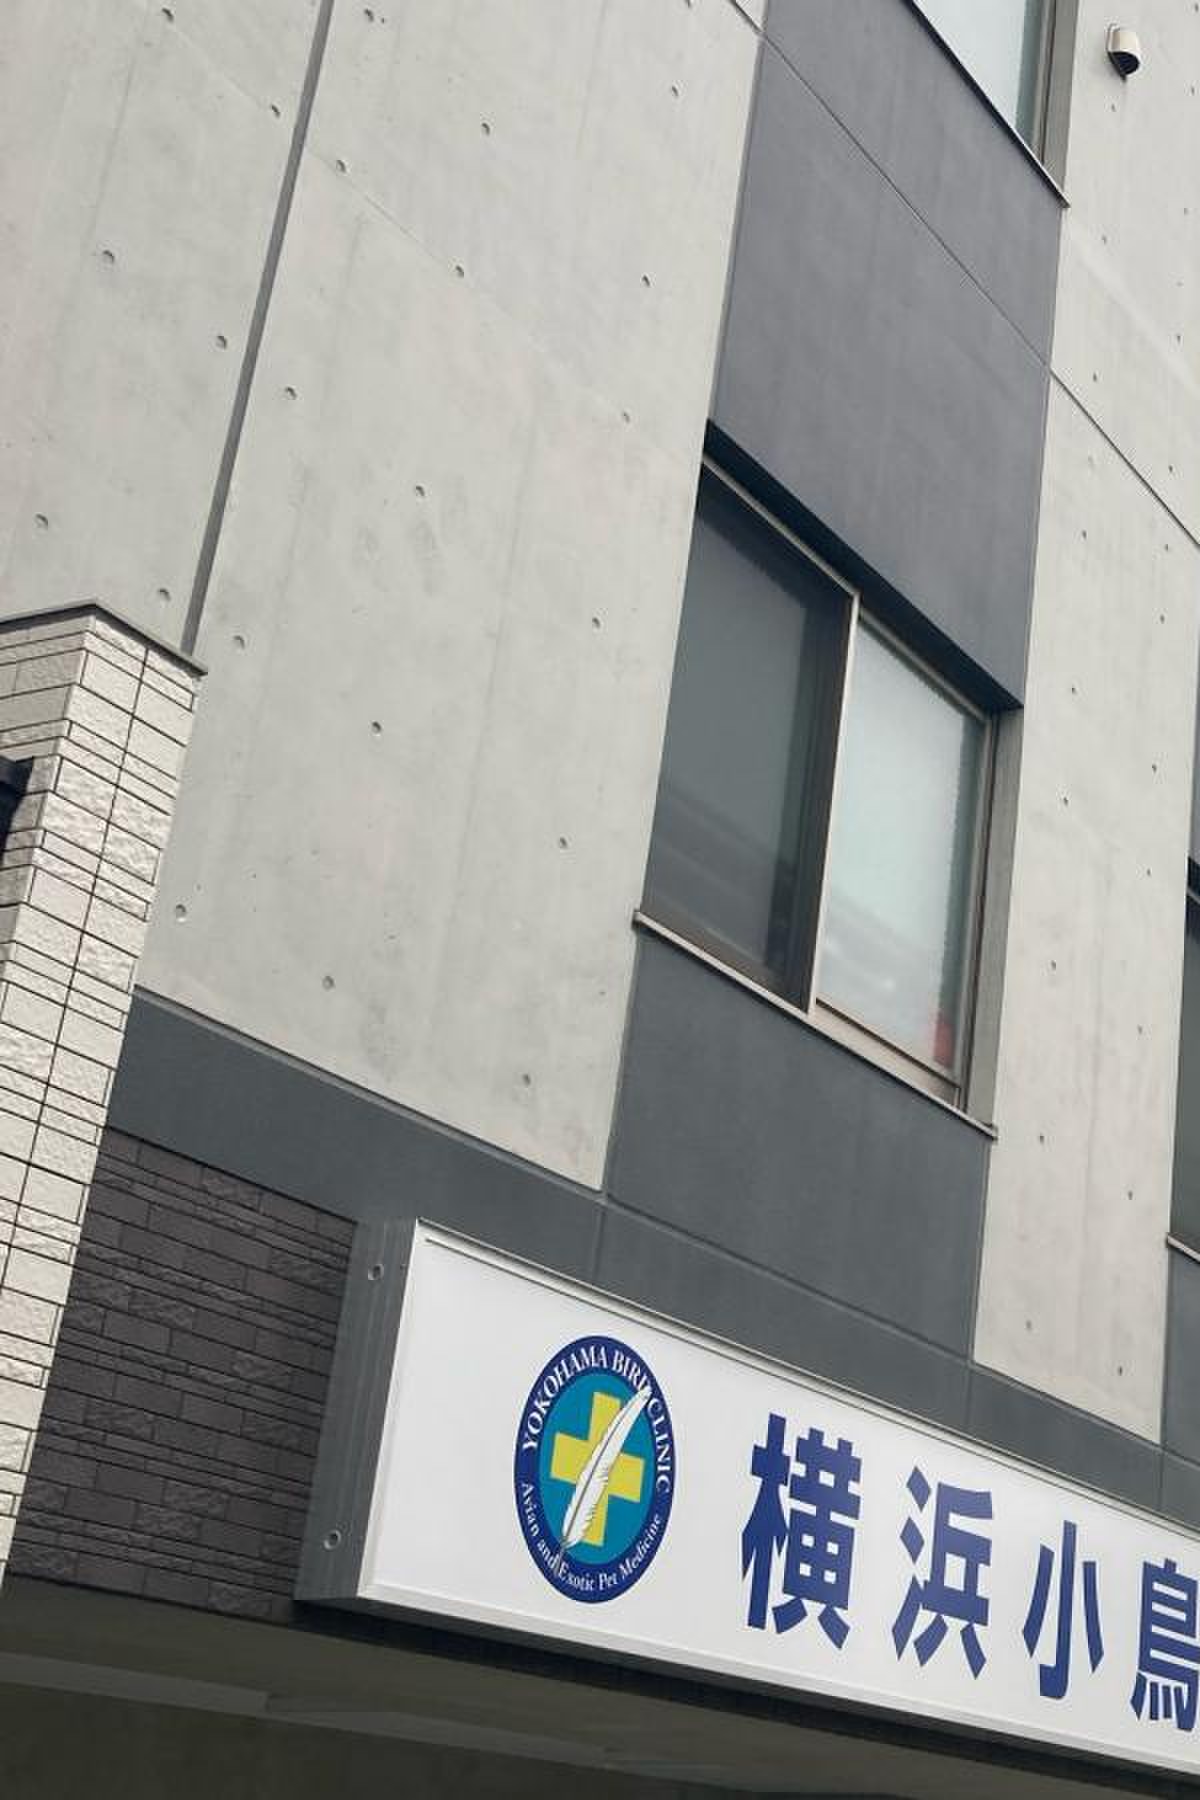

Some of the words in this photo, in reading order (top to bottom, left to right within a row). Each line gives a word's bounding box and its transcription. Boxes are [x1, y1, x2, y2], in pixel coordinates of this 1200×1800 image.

[523, 1346, 607, 1450] YOKOHAMA
[648, 1398, 671, 1494] CLINIC
[521, 1482, 540, 1537] Avian
